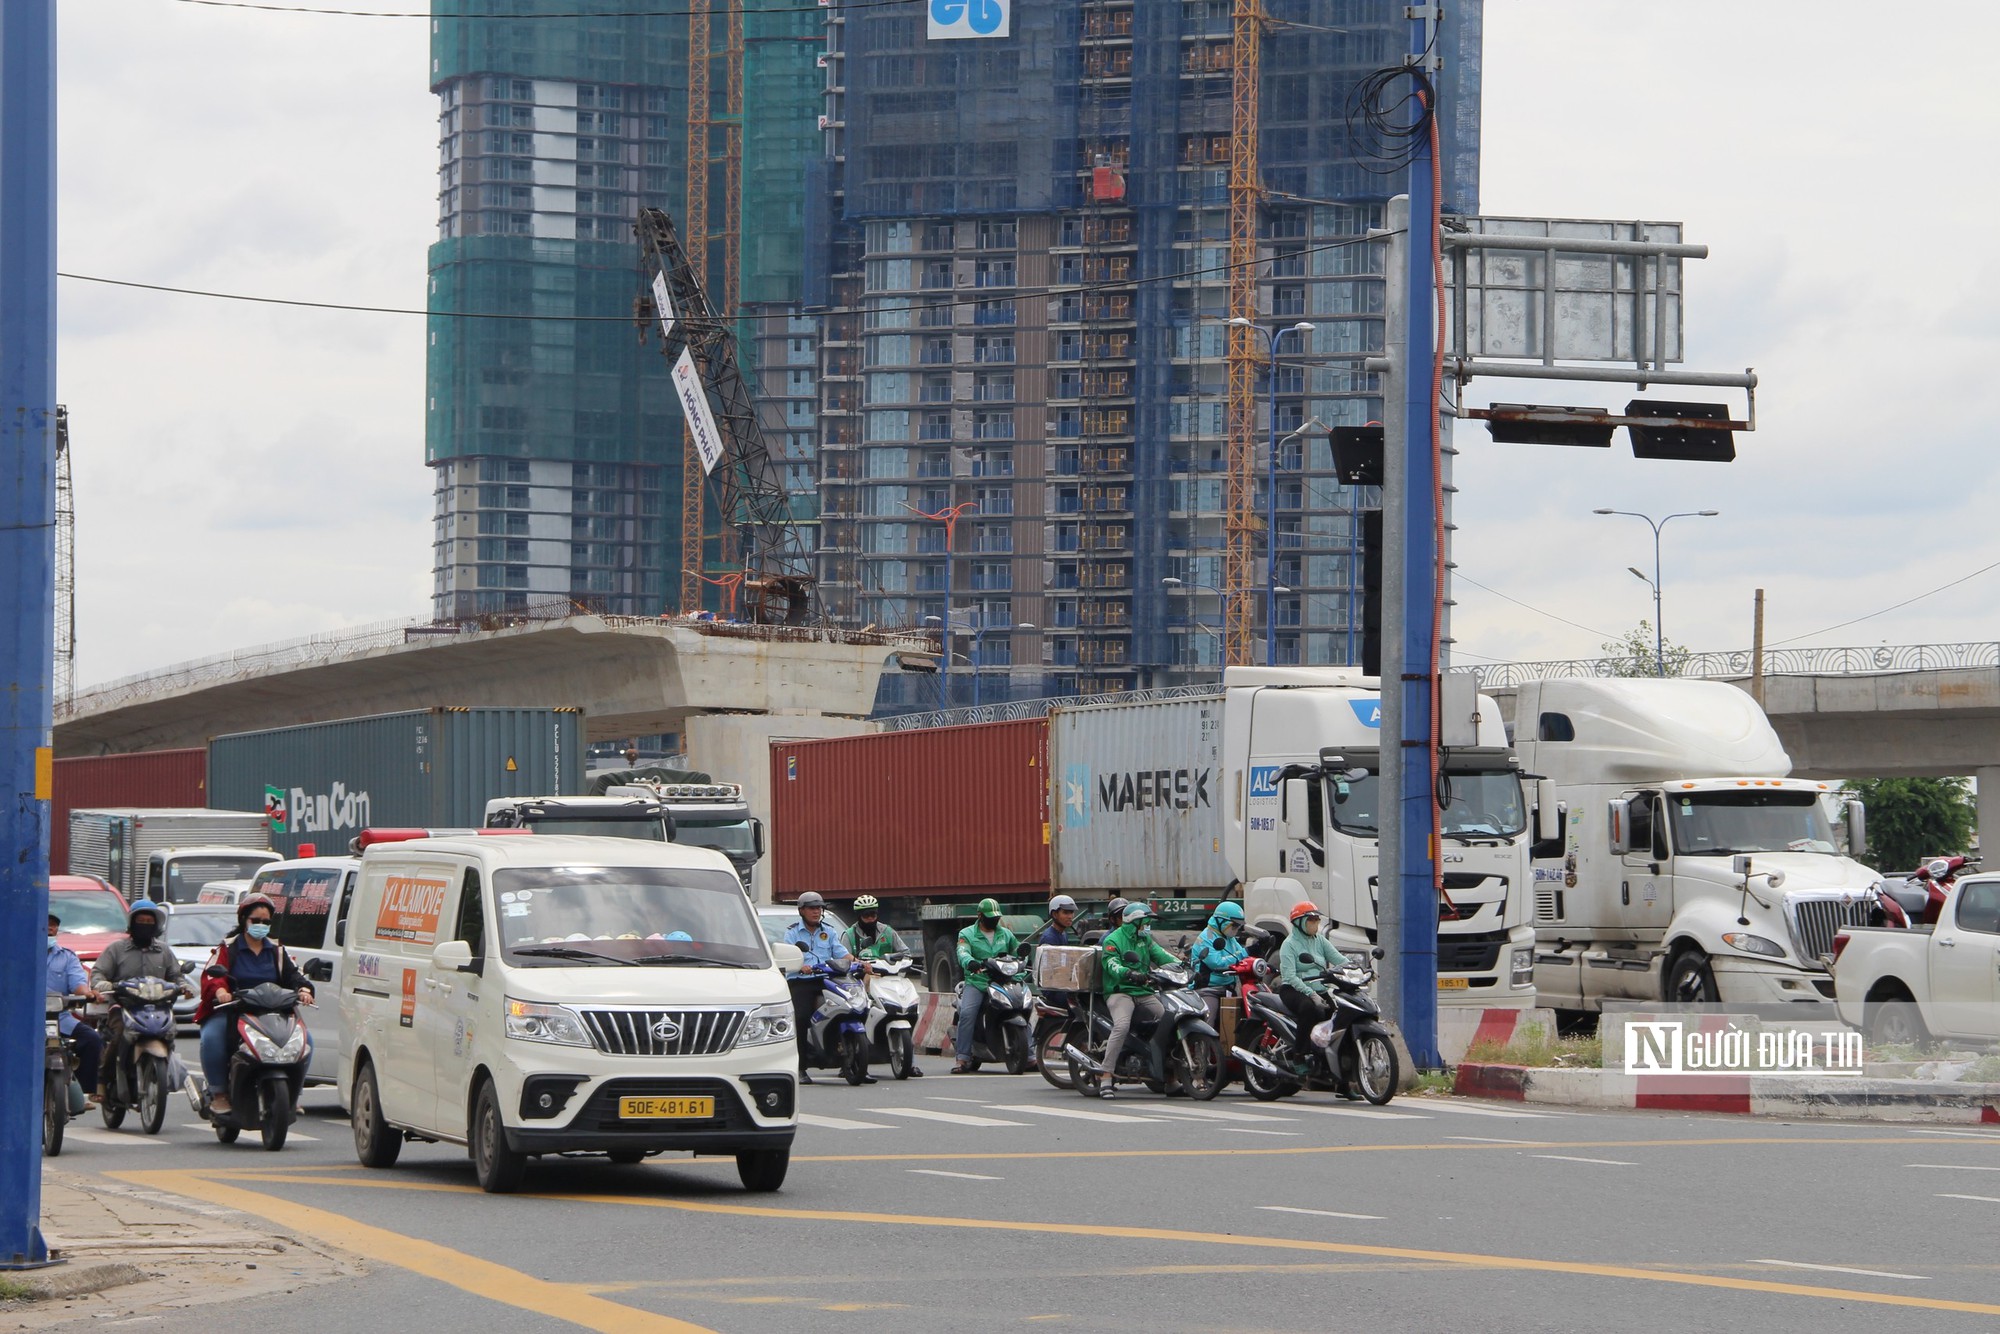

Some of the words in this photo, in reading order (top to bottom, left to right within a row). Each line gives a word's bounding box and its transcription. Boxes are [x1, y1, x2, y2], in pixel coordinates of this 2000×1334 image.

[1099, 767, 1211, 812] MAERSK
[290, 781, 370, 833] PanCon
[1249, 797, 1278, 806] LOGISTICS
[389, 882, 446, 916] LALAMOVE
[1164, 901, 1188, 913] 234
[1437, 978, 1464, 988] -185.17
[627, 1101, 705, 1114] 50E-481.61
